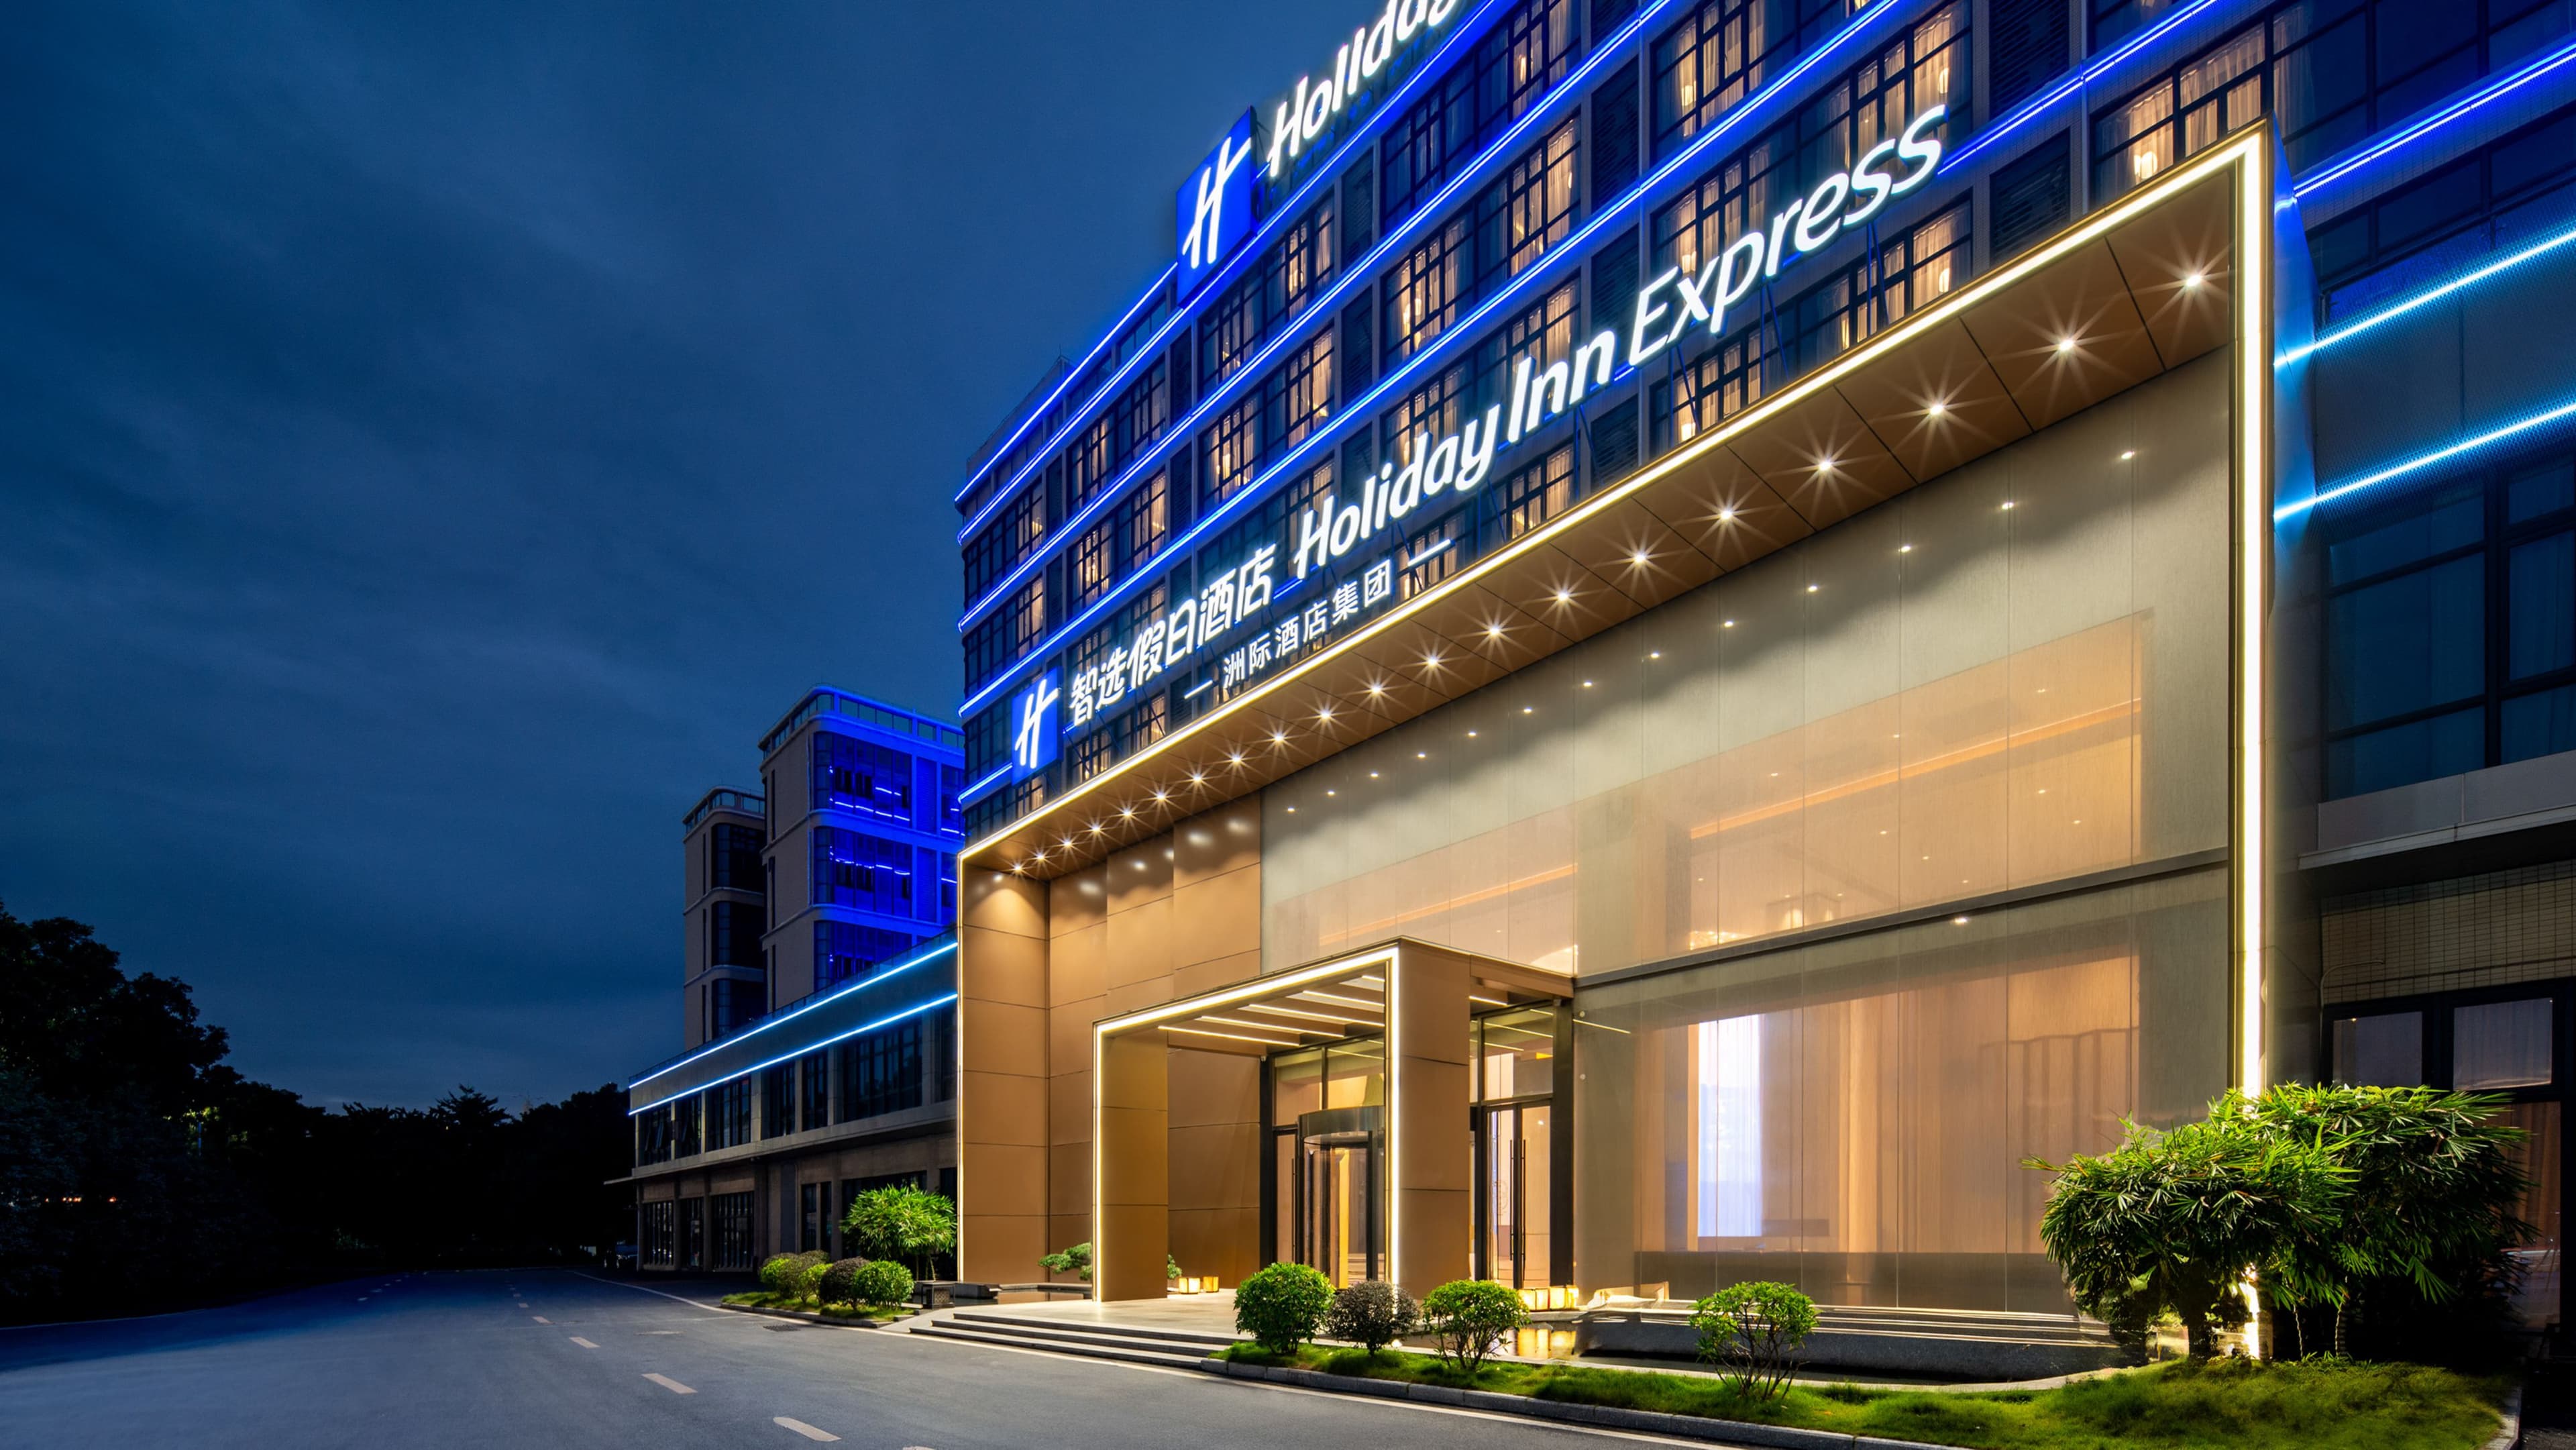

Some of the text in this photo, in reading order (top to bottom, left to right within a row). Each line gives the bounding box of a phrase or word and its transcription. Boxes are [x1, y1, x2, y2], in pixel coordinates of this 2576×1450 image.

[1293, 103, 1946, 580] Holiday Inn Express
[1069, 543, 1276, 727] 智选假日酒店
[1222, 558, 1391, 692] 洲际酒店集团
